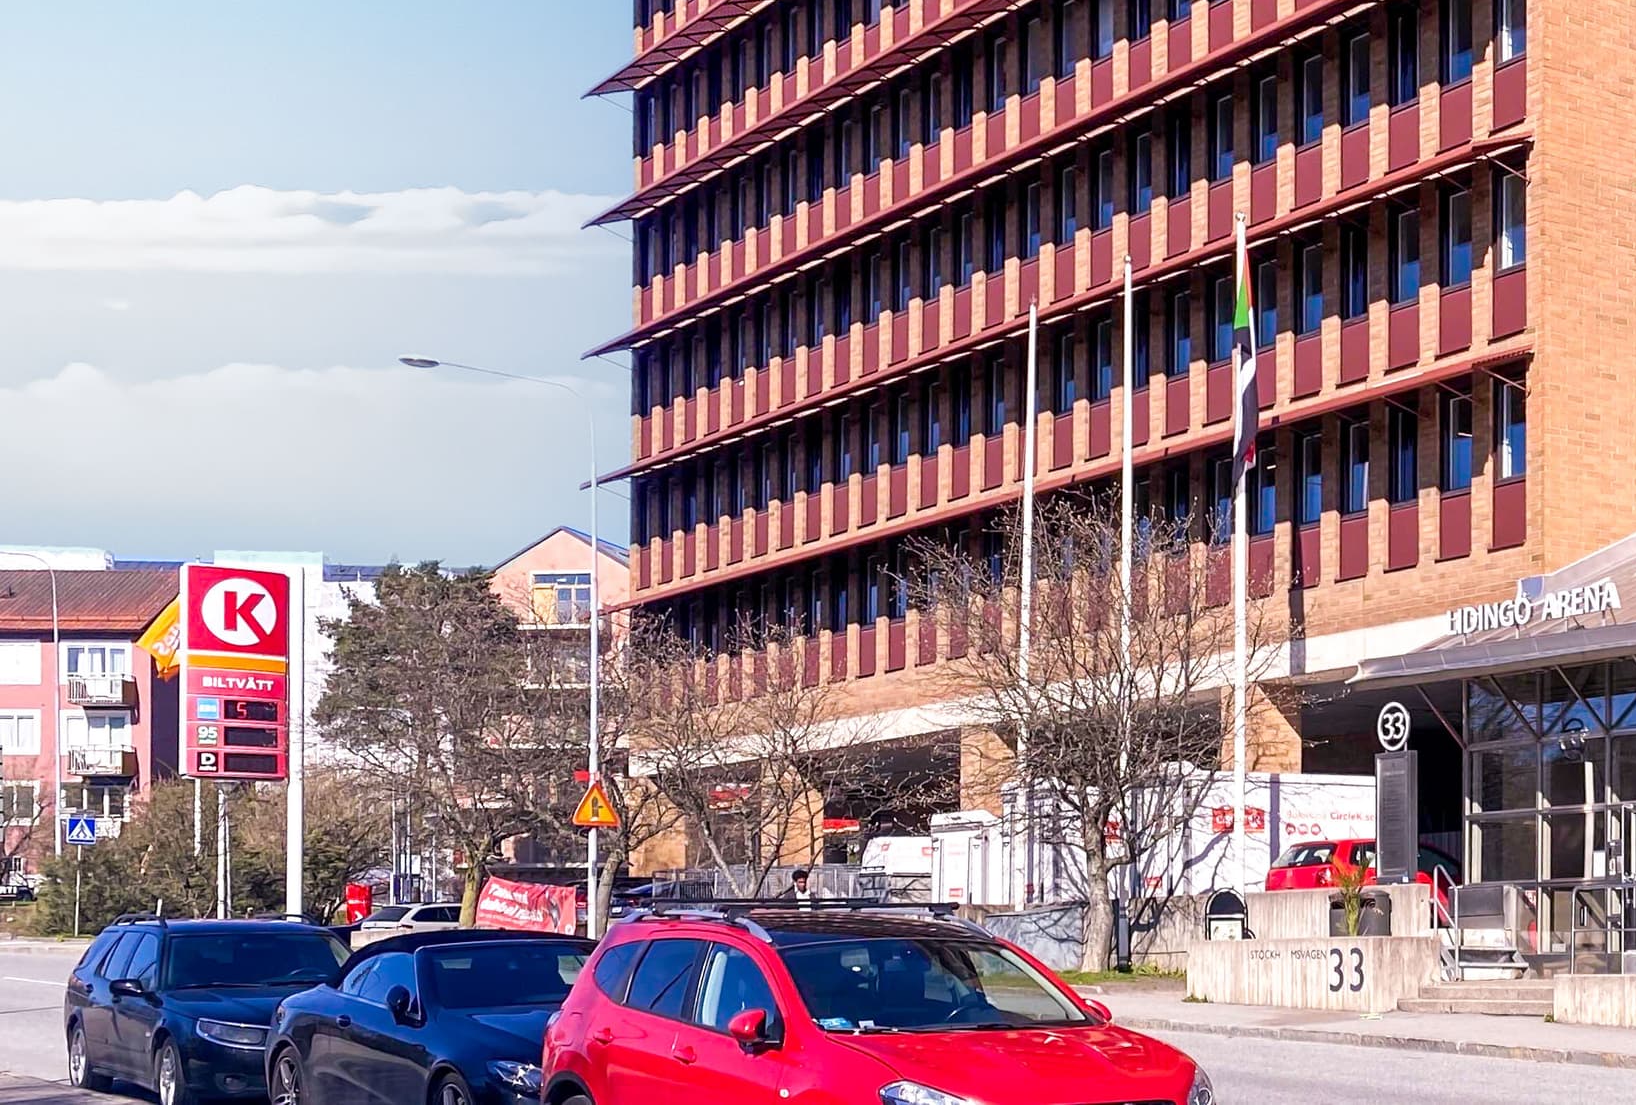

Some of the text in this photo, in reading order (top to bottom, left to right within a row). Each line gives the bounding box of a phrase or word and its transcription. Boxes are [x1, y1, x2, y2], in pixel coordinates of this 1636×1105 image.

[1446, 576, 1622, 636] LIDINGÖ ARENA
[197, 726, 218, 740] 95
[1382, 711, 1406, 741] 33
[200, 753, 217, 766] D
[1329, 947, 1365, 993] 33
